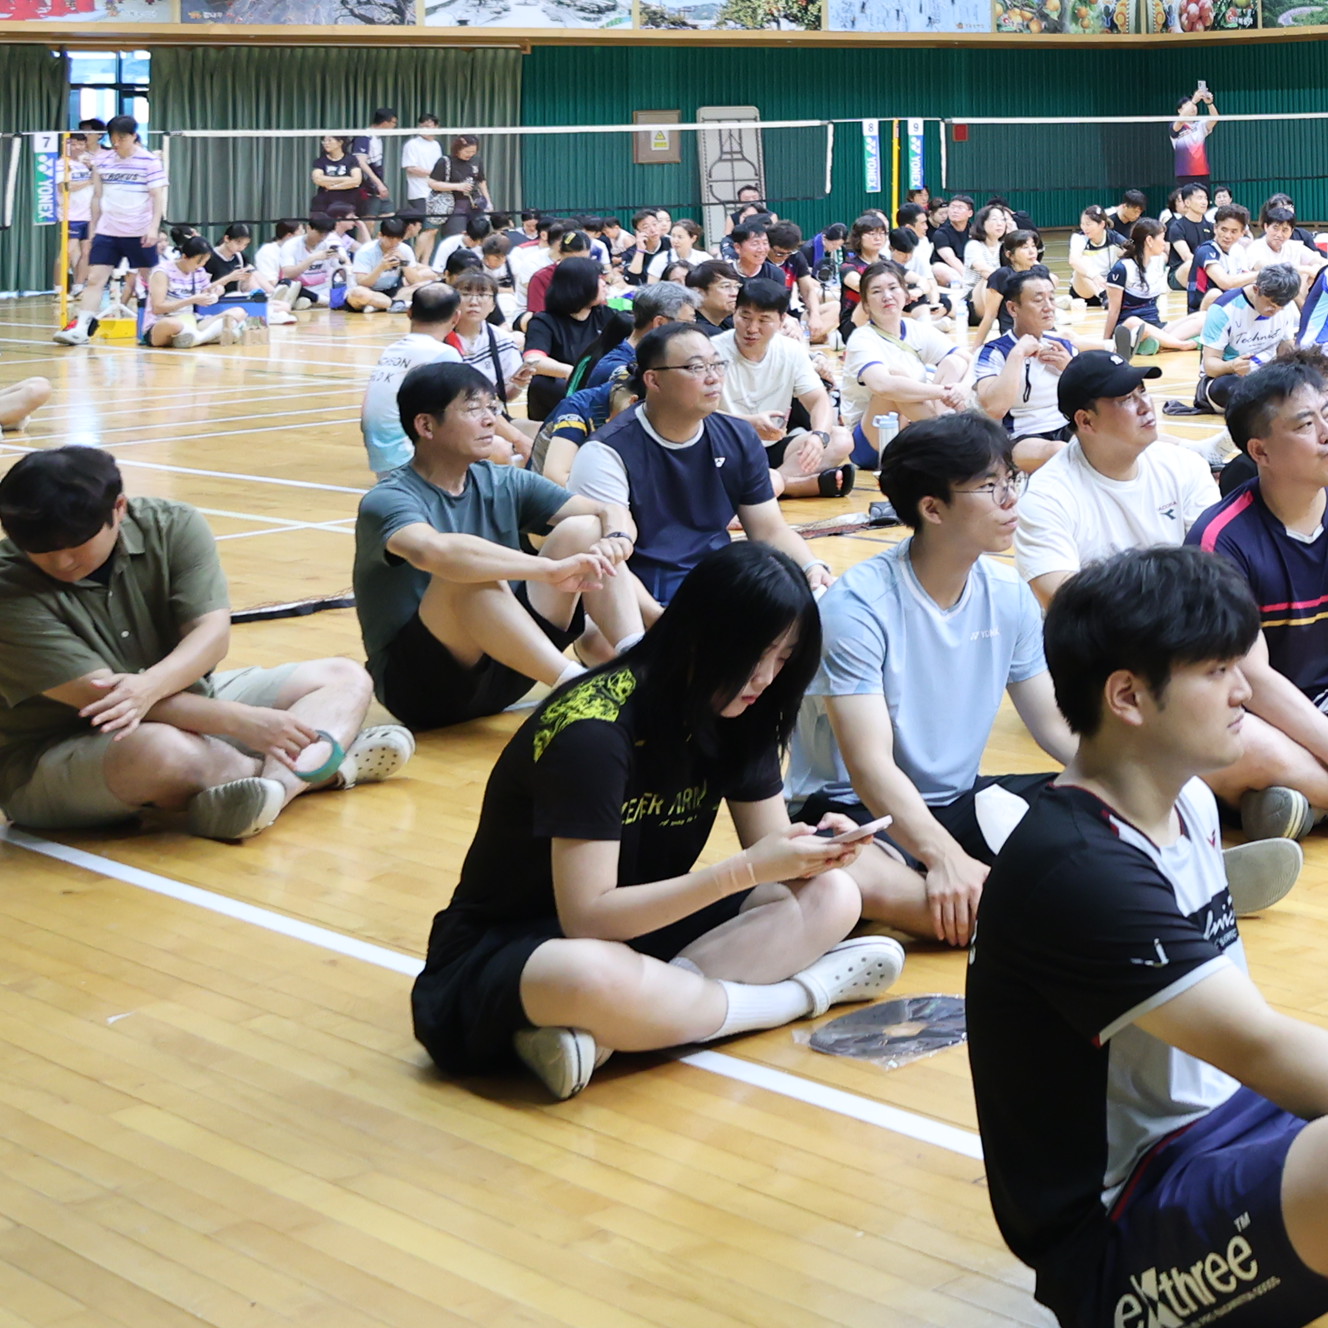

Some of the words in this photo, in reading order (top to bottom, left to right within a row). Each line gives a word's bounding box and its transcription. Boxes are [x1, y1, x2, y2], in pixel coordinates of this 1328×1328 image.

[868, 123, 874, 132] 8
[913, 123, 919, 132] 9
[42, 136, 51, 148] 7
[866, 157, 878, 188] YONEX
[911, 156, 922, 188] YONEX
[38, 181, 54, 219] YONEX
[1236, 328, 1281, 345] Technist
